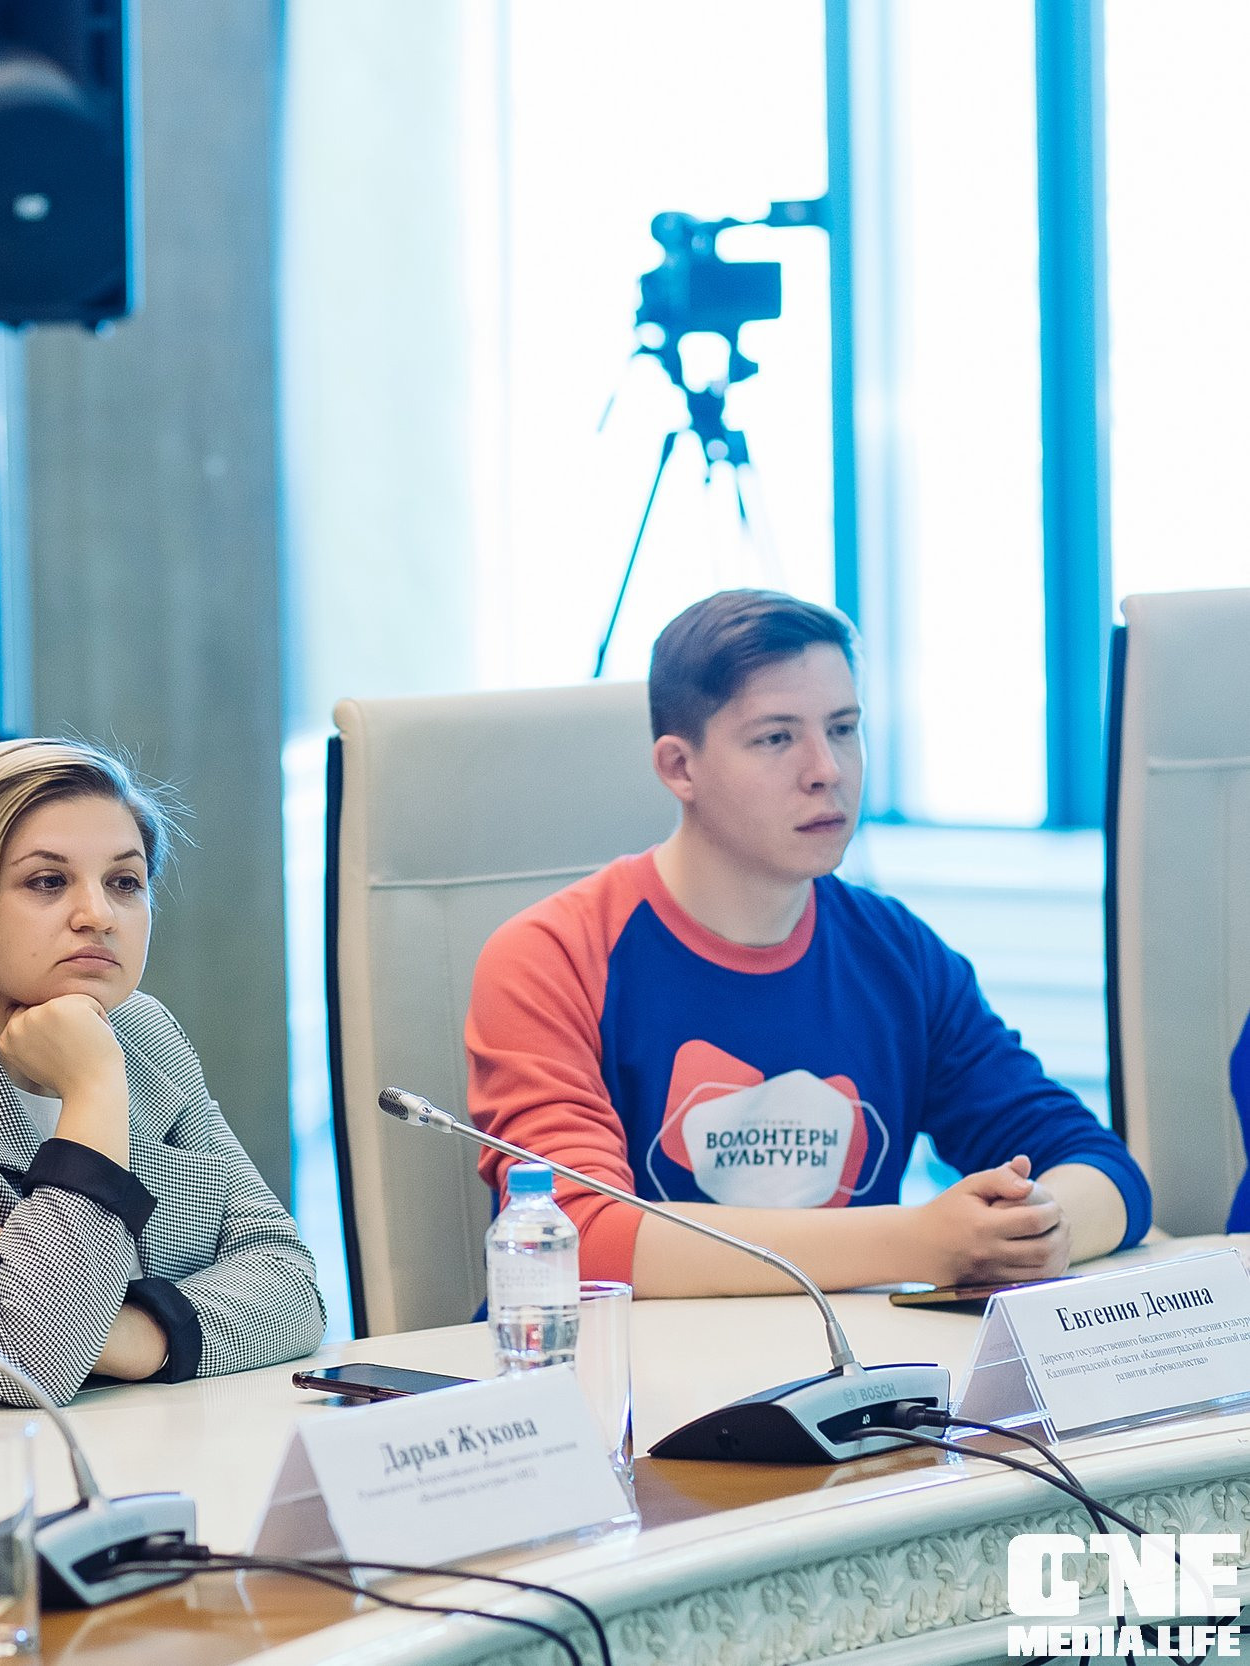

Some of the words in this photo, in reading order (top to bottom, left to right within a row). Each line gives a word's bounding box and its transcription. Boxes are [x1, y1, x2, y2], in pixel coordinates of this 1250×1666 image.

[706, 1128, 838, 1150] ВОЛОНТЕРЫ
[714, 1148, 827, 1168] КУЛЬТУРЫ
[1055, 1300, 1140, 1332] Евгения
[1140, 1287, 1214, 1321] Демина
[1039, 1350, 1076, 1366] Директор
[1075, 1340, 1139, 1357] государственного
[1111, 1350, 1141, 1365] области
[859, 1383, 897, 1401] BOSCH
[379, 1438, 450, 1476] Дарья
[449, 1417, 538, 1456] Жукова
